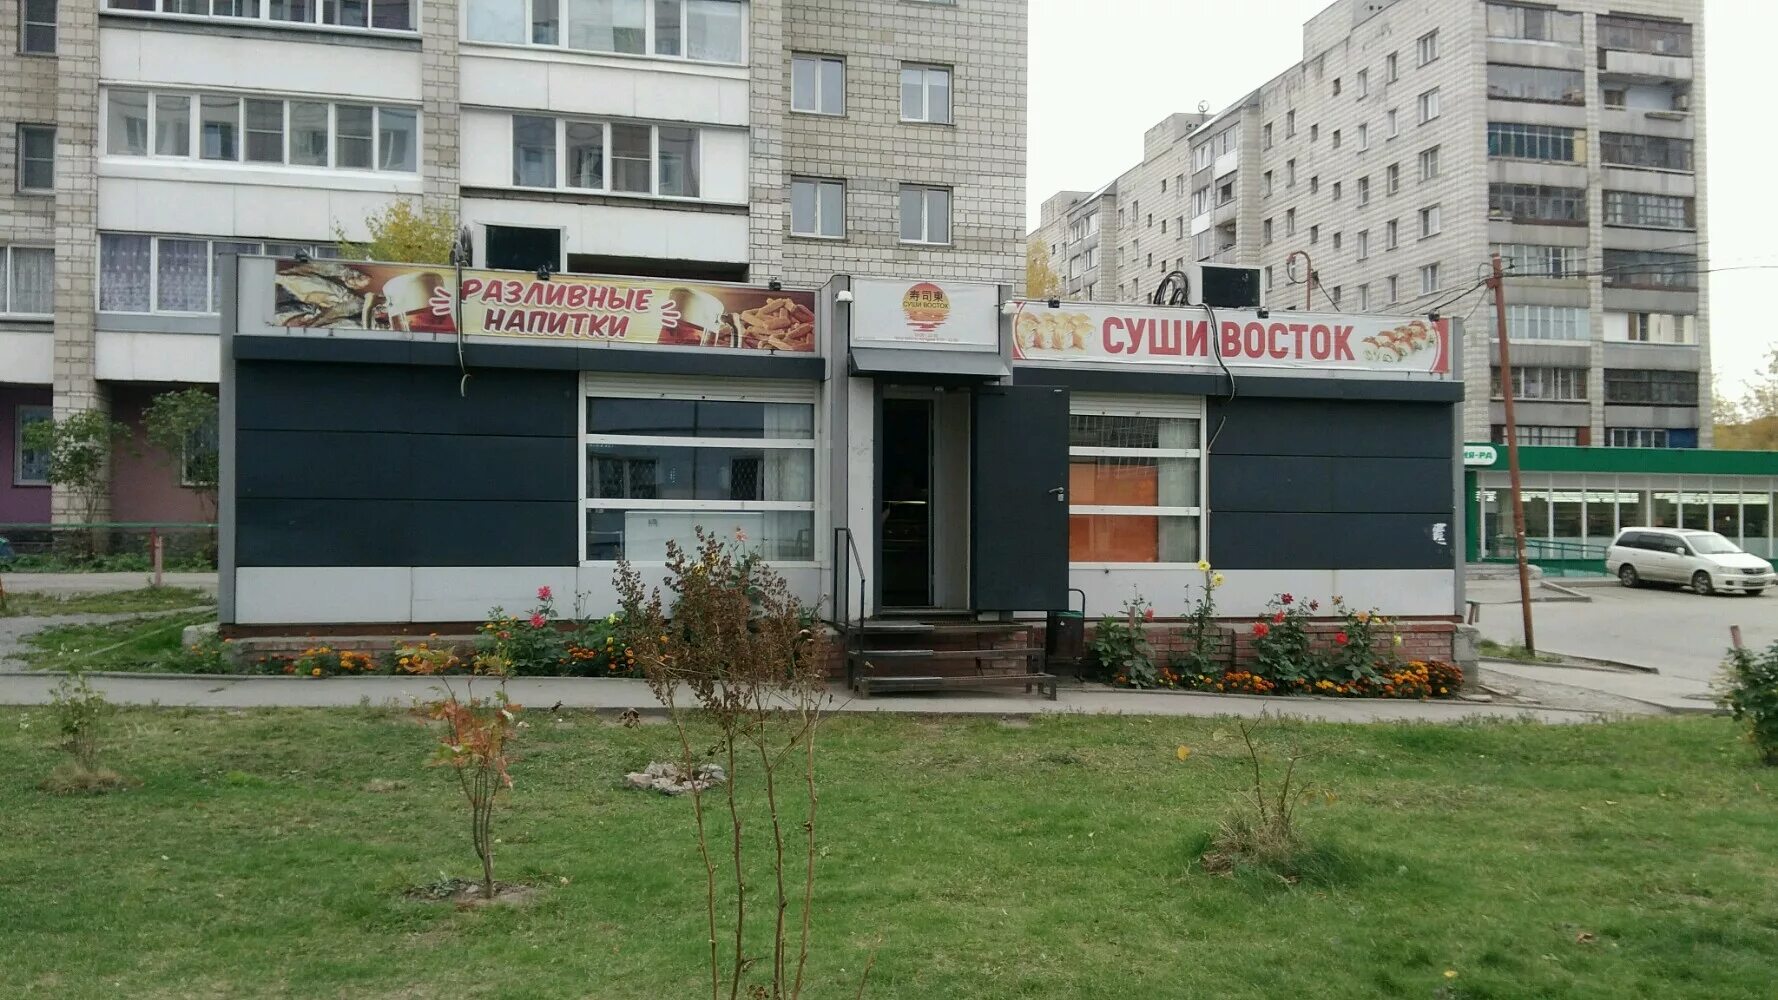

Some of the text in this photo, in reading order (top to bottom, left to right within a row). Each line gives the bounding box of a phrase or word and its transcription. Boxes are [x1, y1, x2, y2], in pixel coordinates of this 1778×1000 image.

[461, 278, 653, 311] РАЗЛИВНЫЕ
[923, 301, 949, 309] ВОСТОК
[484, 308, 630, 338] НАПИТКИ
[1102, 316, 1356, 361] СУШИ ВОСТОК
